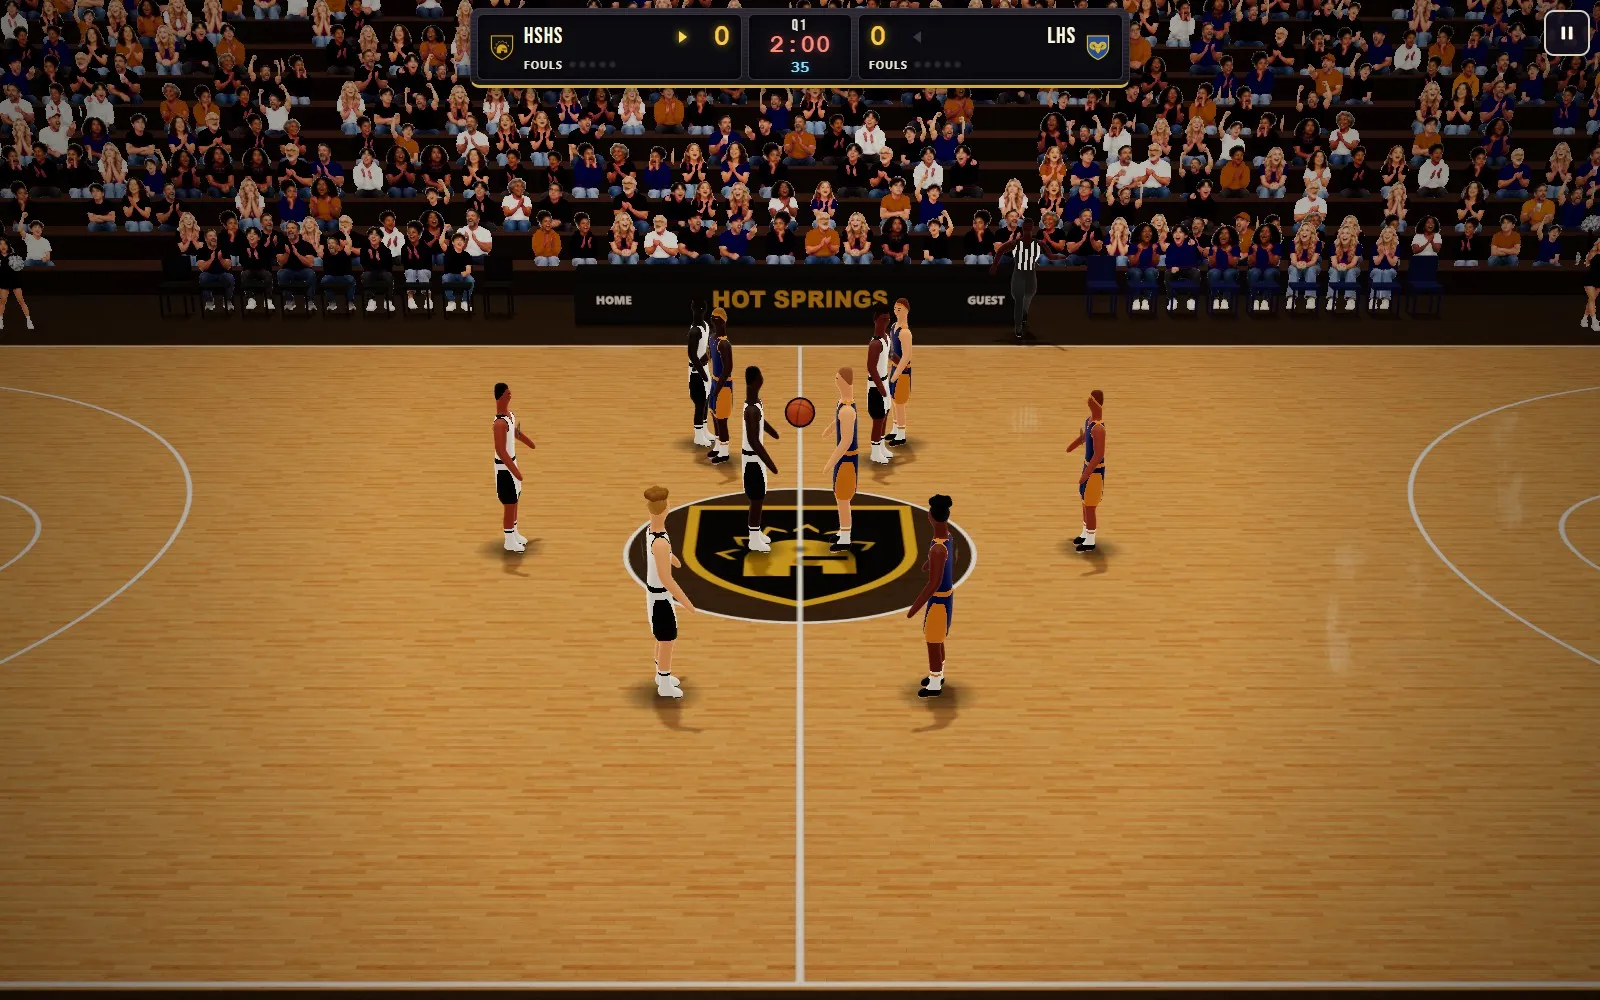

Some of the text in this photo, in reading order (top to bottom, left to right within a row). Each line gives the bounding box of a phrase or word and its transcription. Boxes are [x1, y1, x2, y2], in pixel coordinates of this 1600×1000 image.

[595, 295, 633, 306] HOME
[712, 289, 889, 309] HOT SPRINGS
[967, 295, 1006, 306] GUEST
